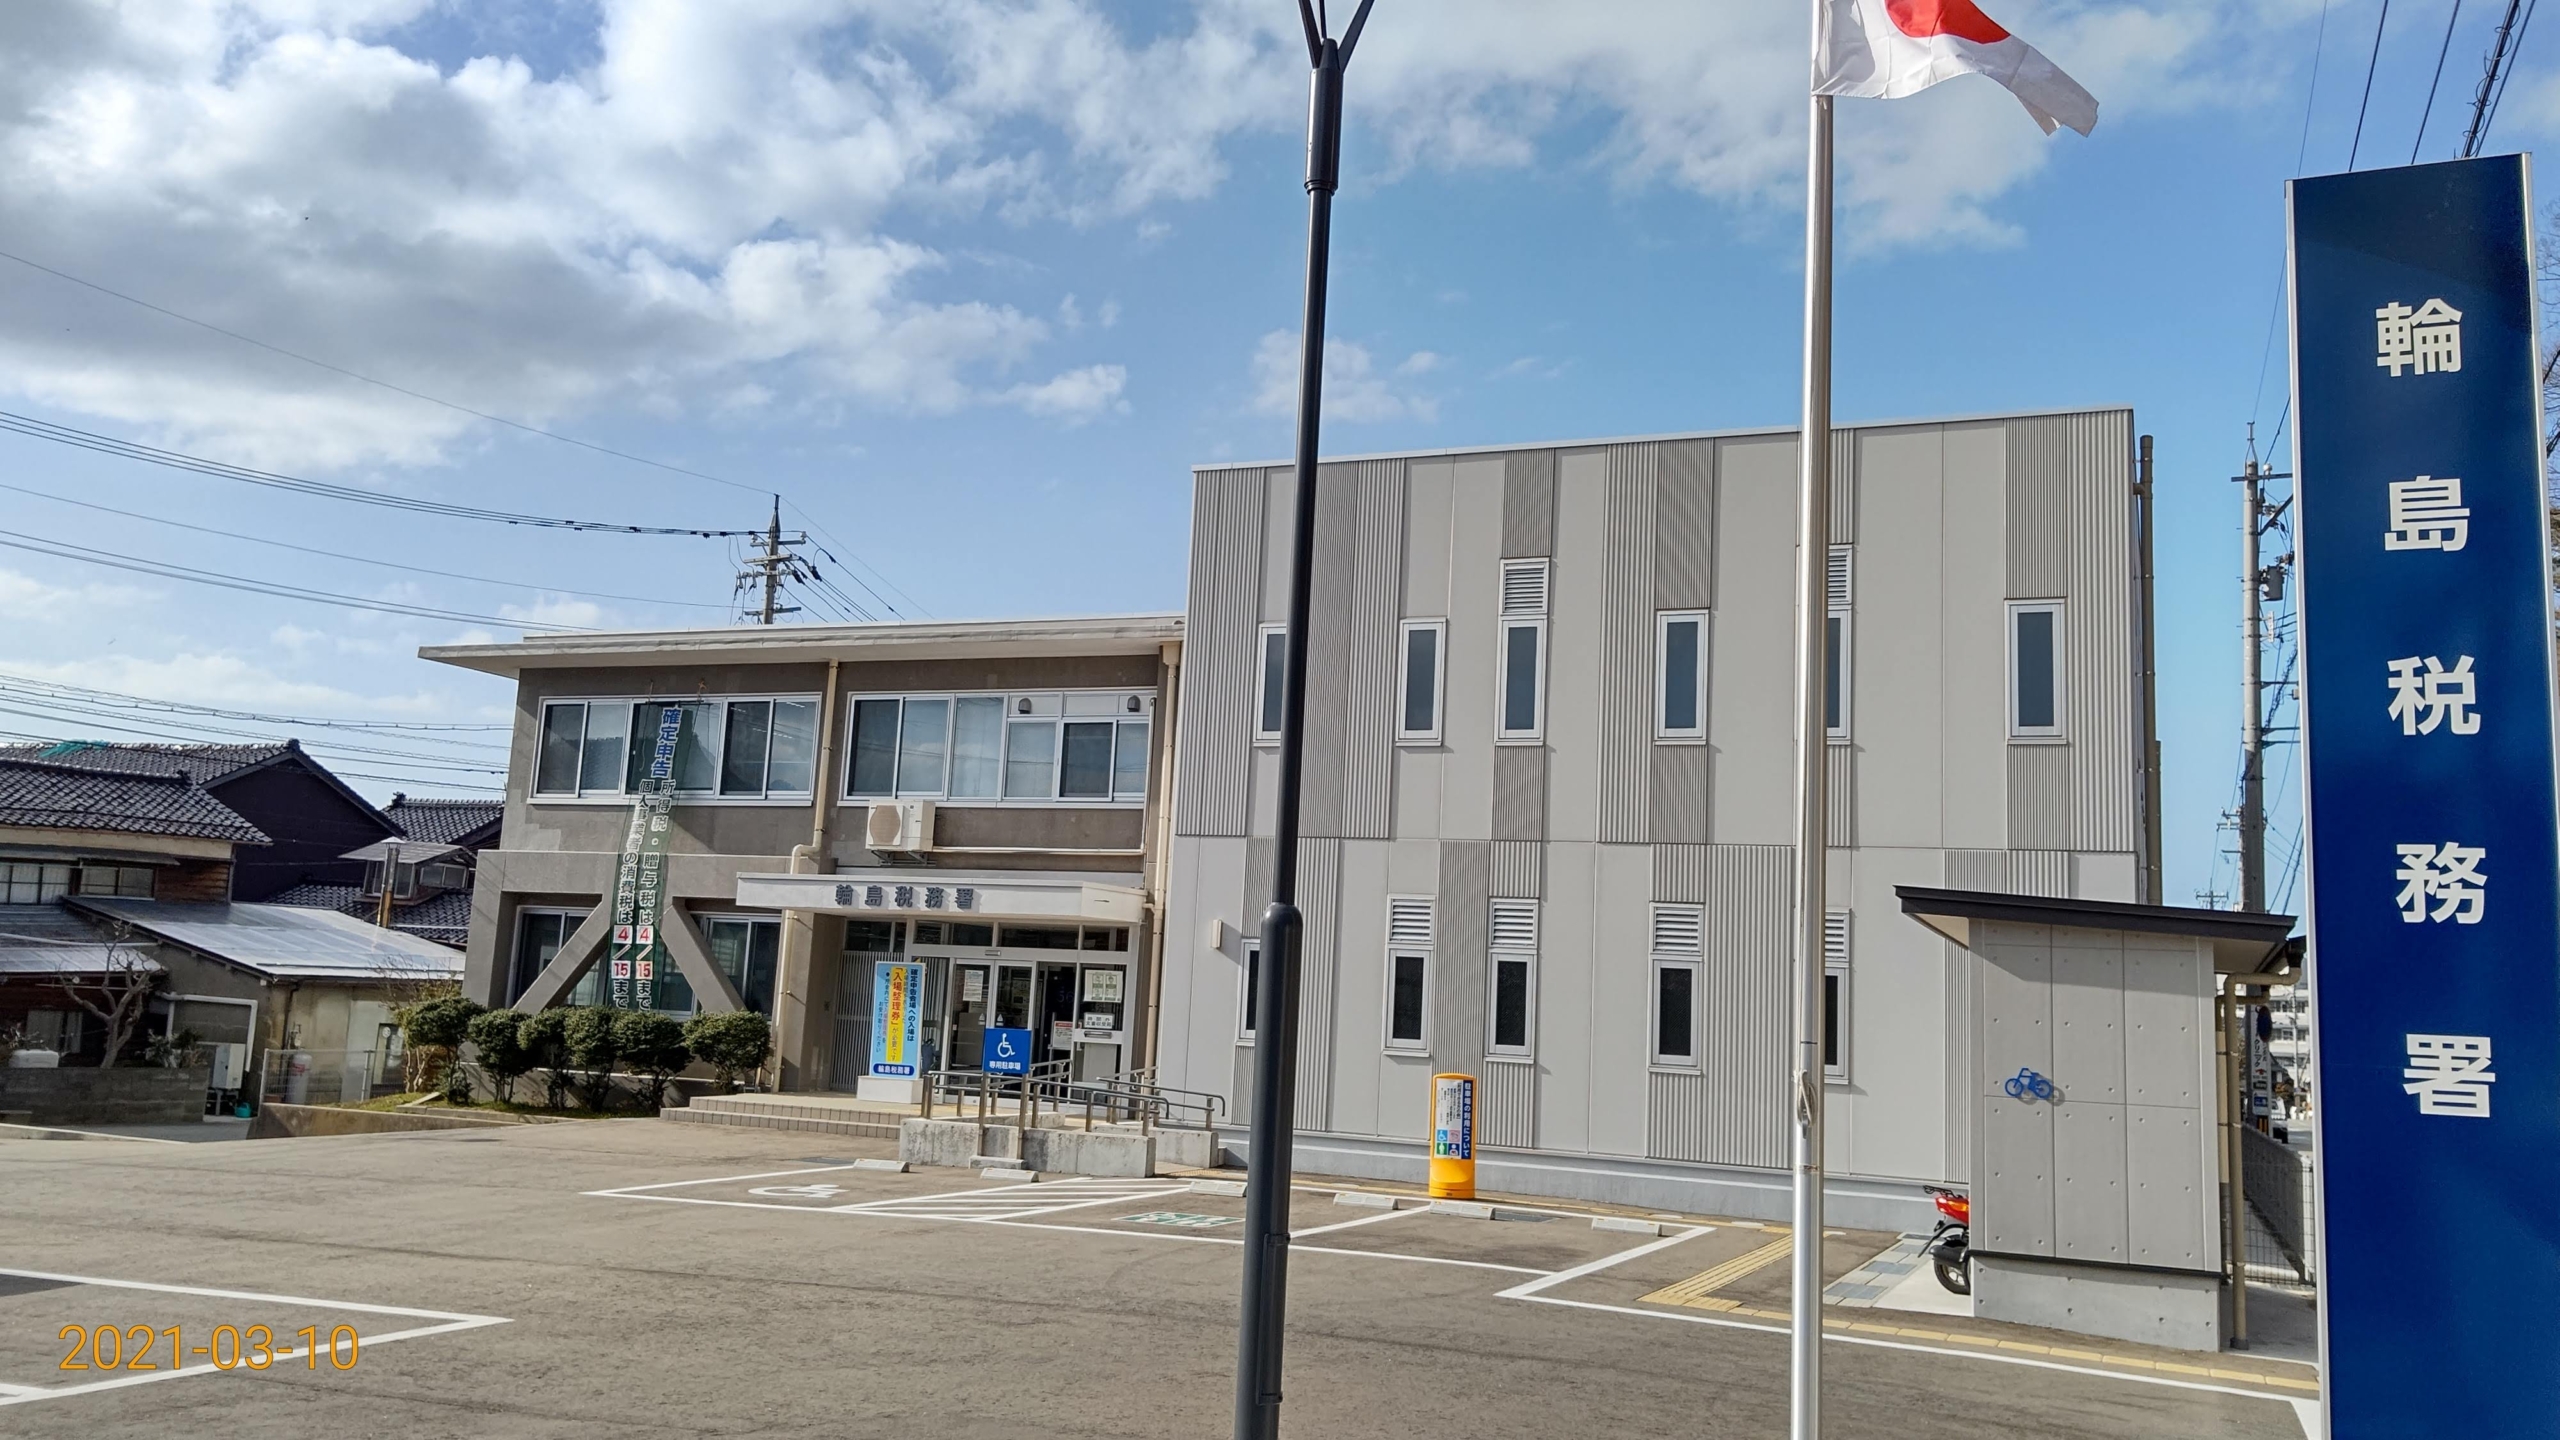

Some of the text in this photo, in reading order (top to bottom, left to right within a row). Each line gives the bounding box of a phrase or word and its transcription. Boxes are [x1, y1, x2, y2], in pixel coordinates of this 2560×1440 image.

[2376, 298, 2496, 1118] 輪島税務署
[651, 705, 683, 778] 確定申告
[835, 884, 974, 909] 輪島税務署
[877, 1064, 911, 1075] 輪島税務署
[989, 1060, 1021, 1070] 専用駐車場
[1463, 1082, 1472, 1157] 駐車場の利用について
